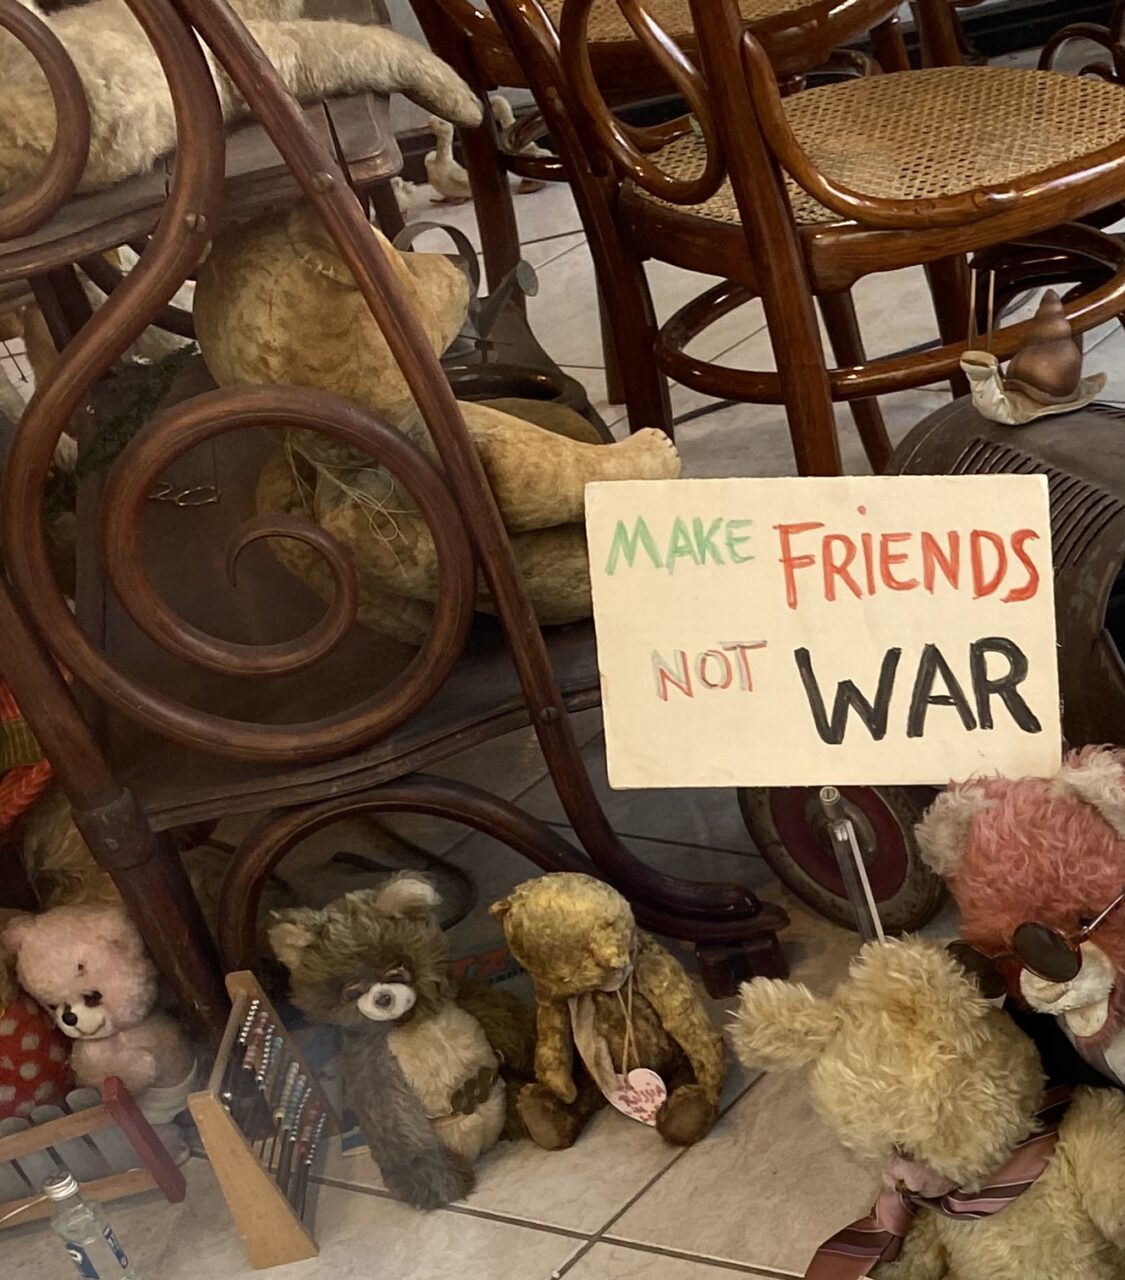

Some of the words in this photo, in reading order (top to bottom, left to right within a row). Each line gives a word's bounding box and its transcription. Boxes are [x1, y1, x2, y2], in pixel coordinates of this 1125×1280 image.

[605, 515, 755, 576] MAKE
[651, 639, 767, 702] NOT
[794, 636, 1043, 746] WAR
